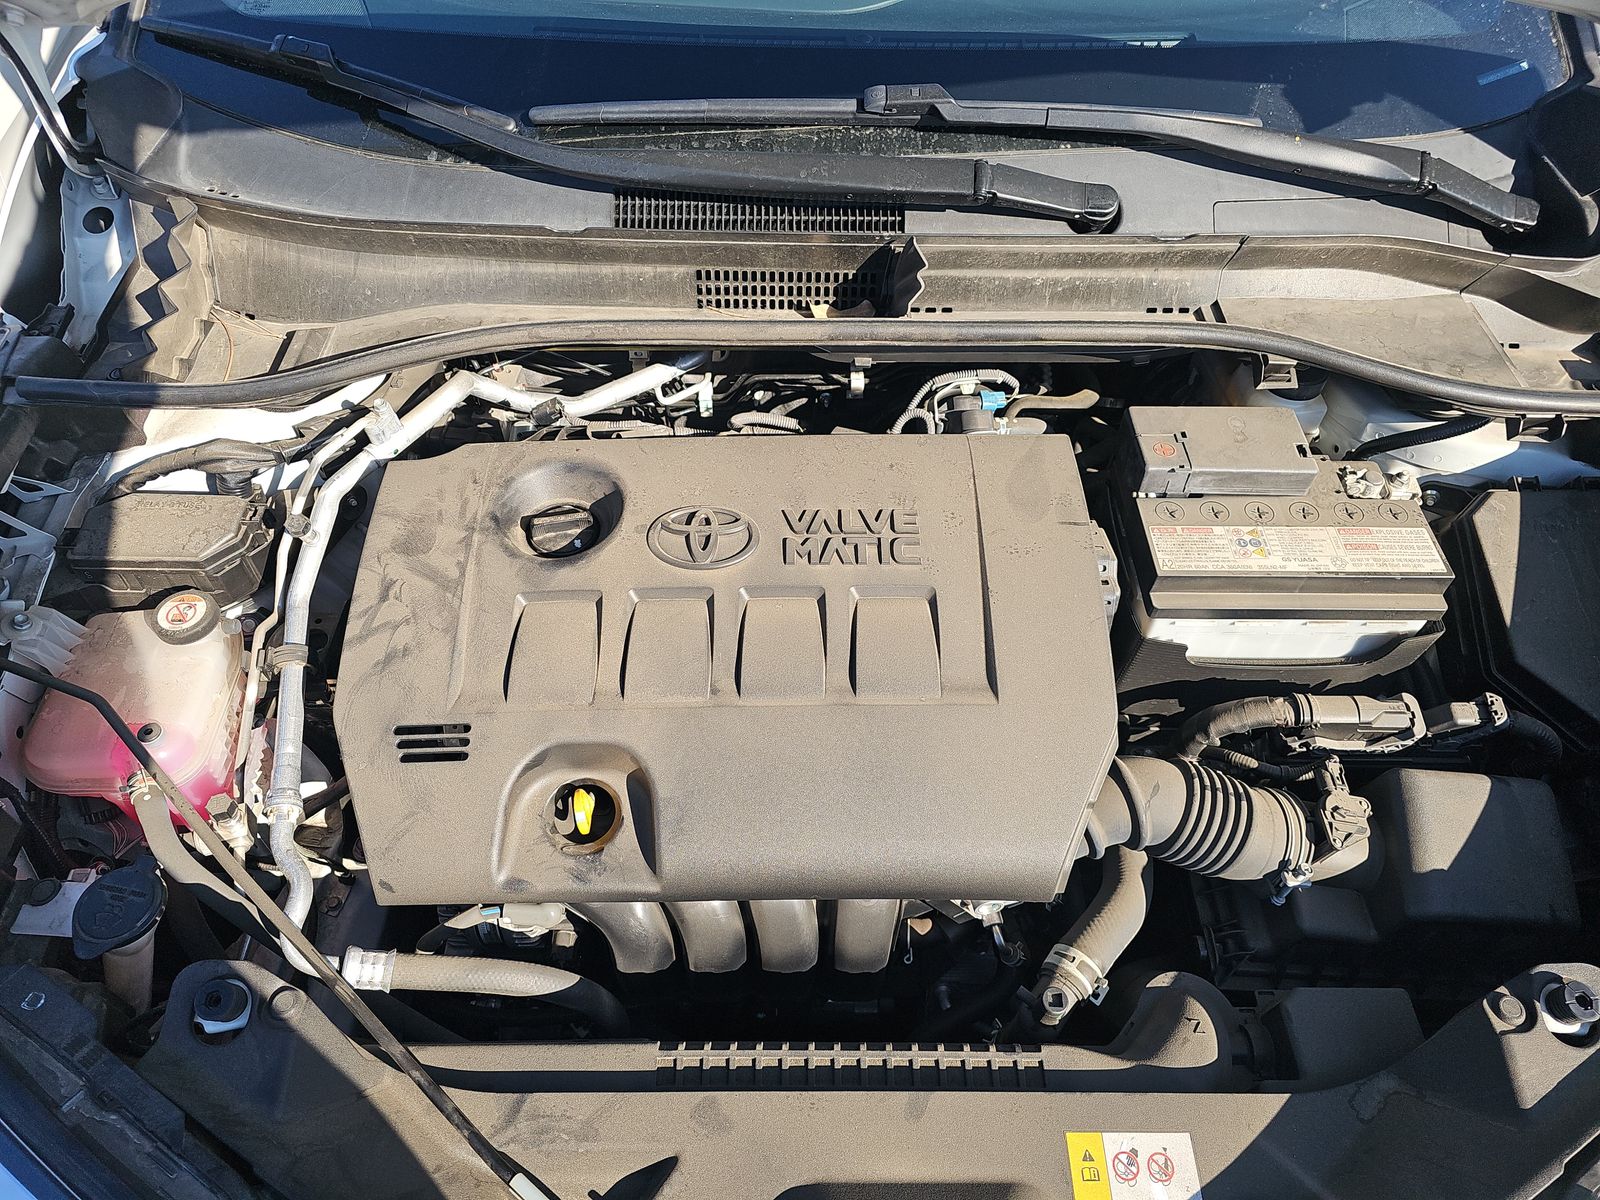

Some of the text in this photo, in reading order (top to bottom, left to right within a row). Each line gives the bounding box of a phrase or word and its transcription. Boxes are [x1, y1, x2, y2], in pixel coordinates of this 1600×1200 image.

[781, 508, 920, 535] VALVE
[782, 537, 922, 566] MATIC
[1162, 559, 1175, 569] A2
